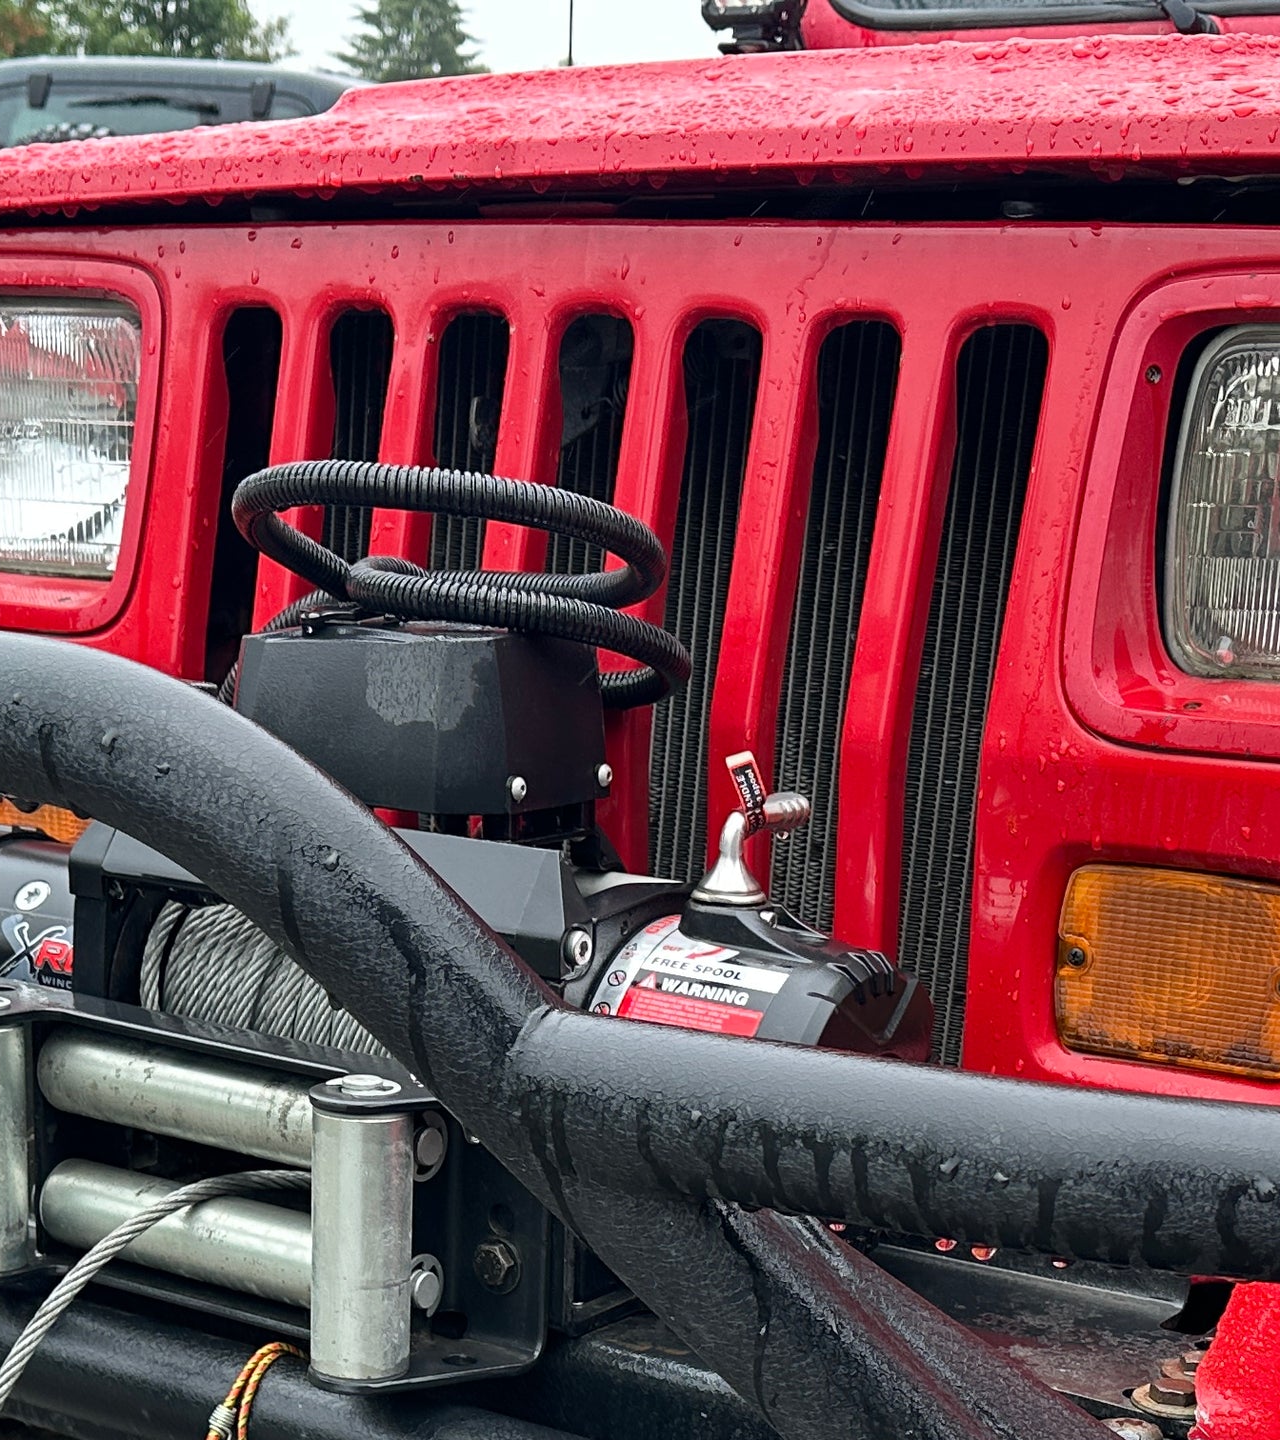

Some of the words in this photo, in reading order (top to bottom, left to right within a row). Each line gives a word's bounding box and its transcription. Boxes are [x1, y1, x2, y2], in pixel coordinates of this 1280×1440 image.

[662, 944, 683, 953] OUT
[651, 957, 689, 971] FREE
[693, 964, 742, 981] SPOOL
[41, 974, 73, 990] WINC
[661, 977, 750, 1006] WARNING
